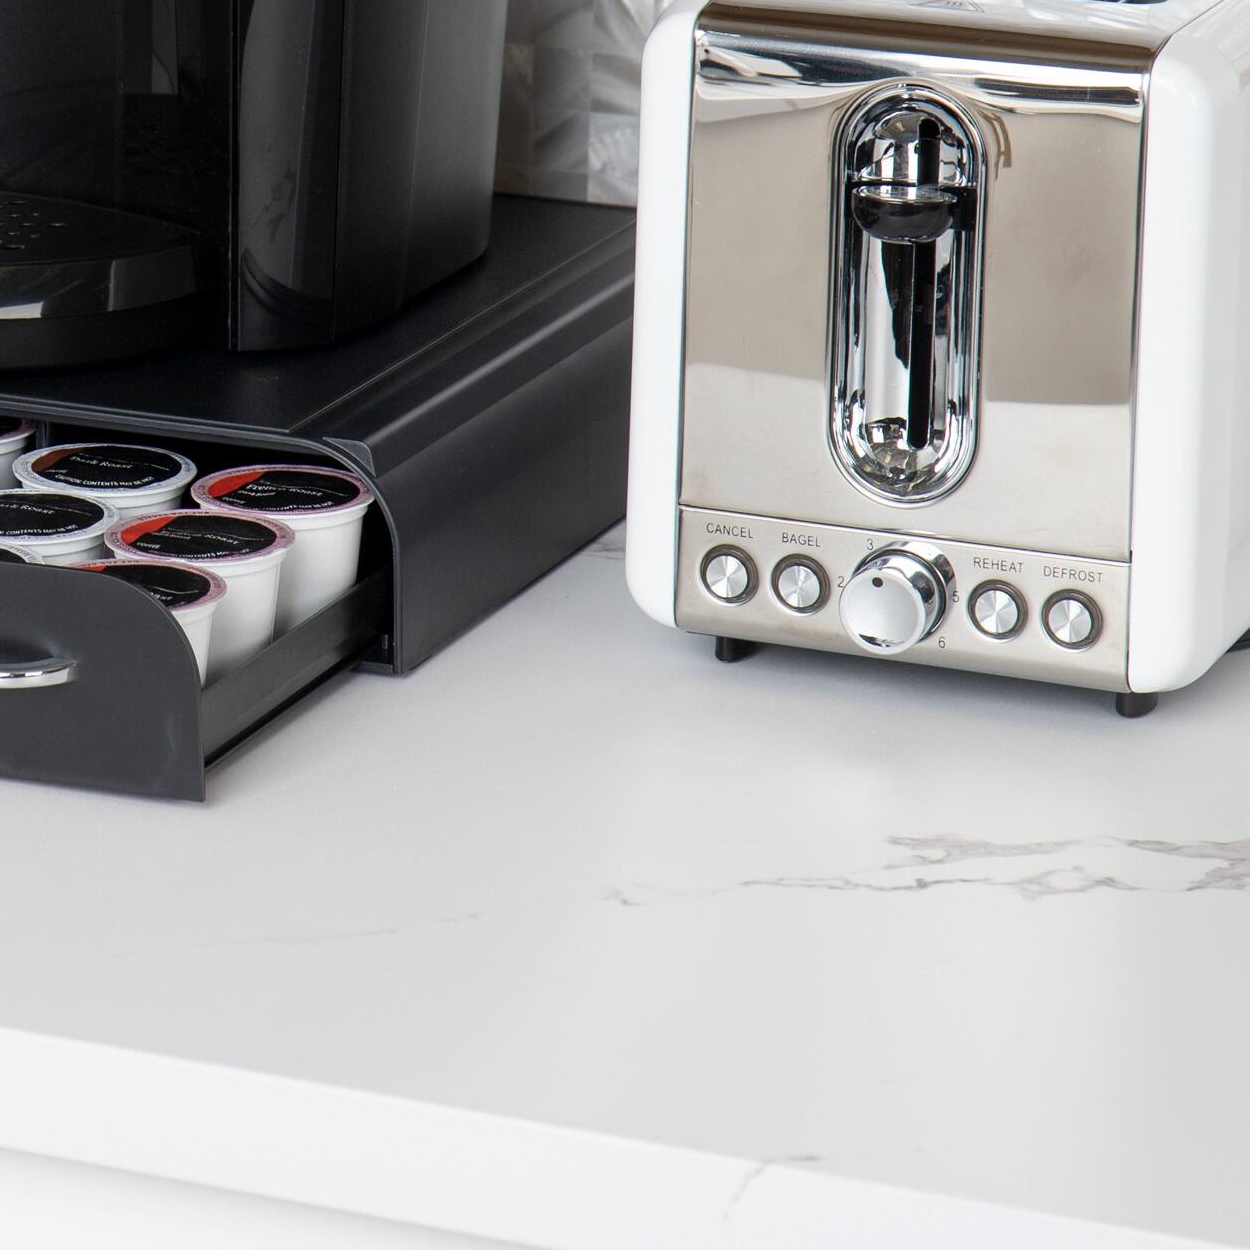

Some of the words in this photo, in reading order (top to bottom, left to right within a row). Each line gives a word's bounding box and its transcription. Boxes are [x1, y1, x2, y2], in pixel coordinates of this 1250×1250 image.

[82, 479, 119, 487] CONTENTS
[19, 503, 56, 515] Roast
[5, 527, 42, 536] CONTENTS
[706, 522, 754, 540] CANCEL
[781, 531, 822, 549] BAGEL
[866, 538, 875, 551] 3
[973, 556, 1024, 573] REHEAT
[1043, 565, 1103, 583] DEFROST
[837, 575, 846, 588] 2
[952, 590, 961, 603] 5
[938, 636, 948, 649] 6
